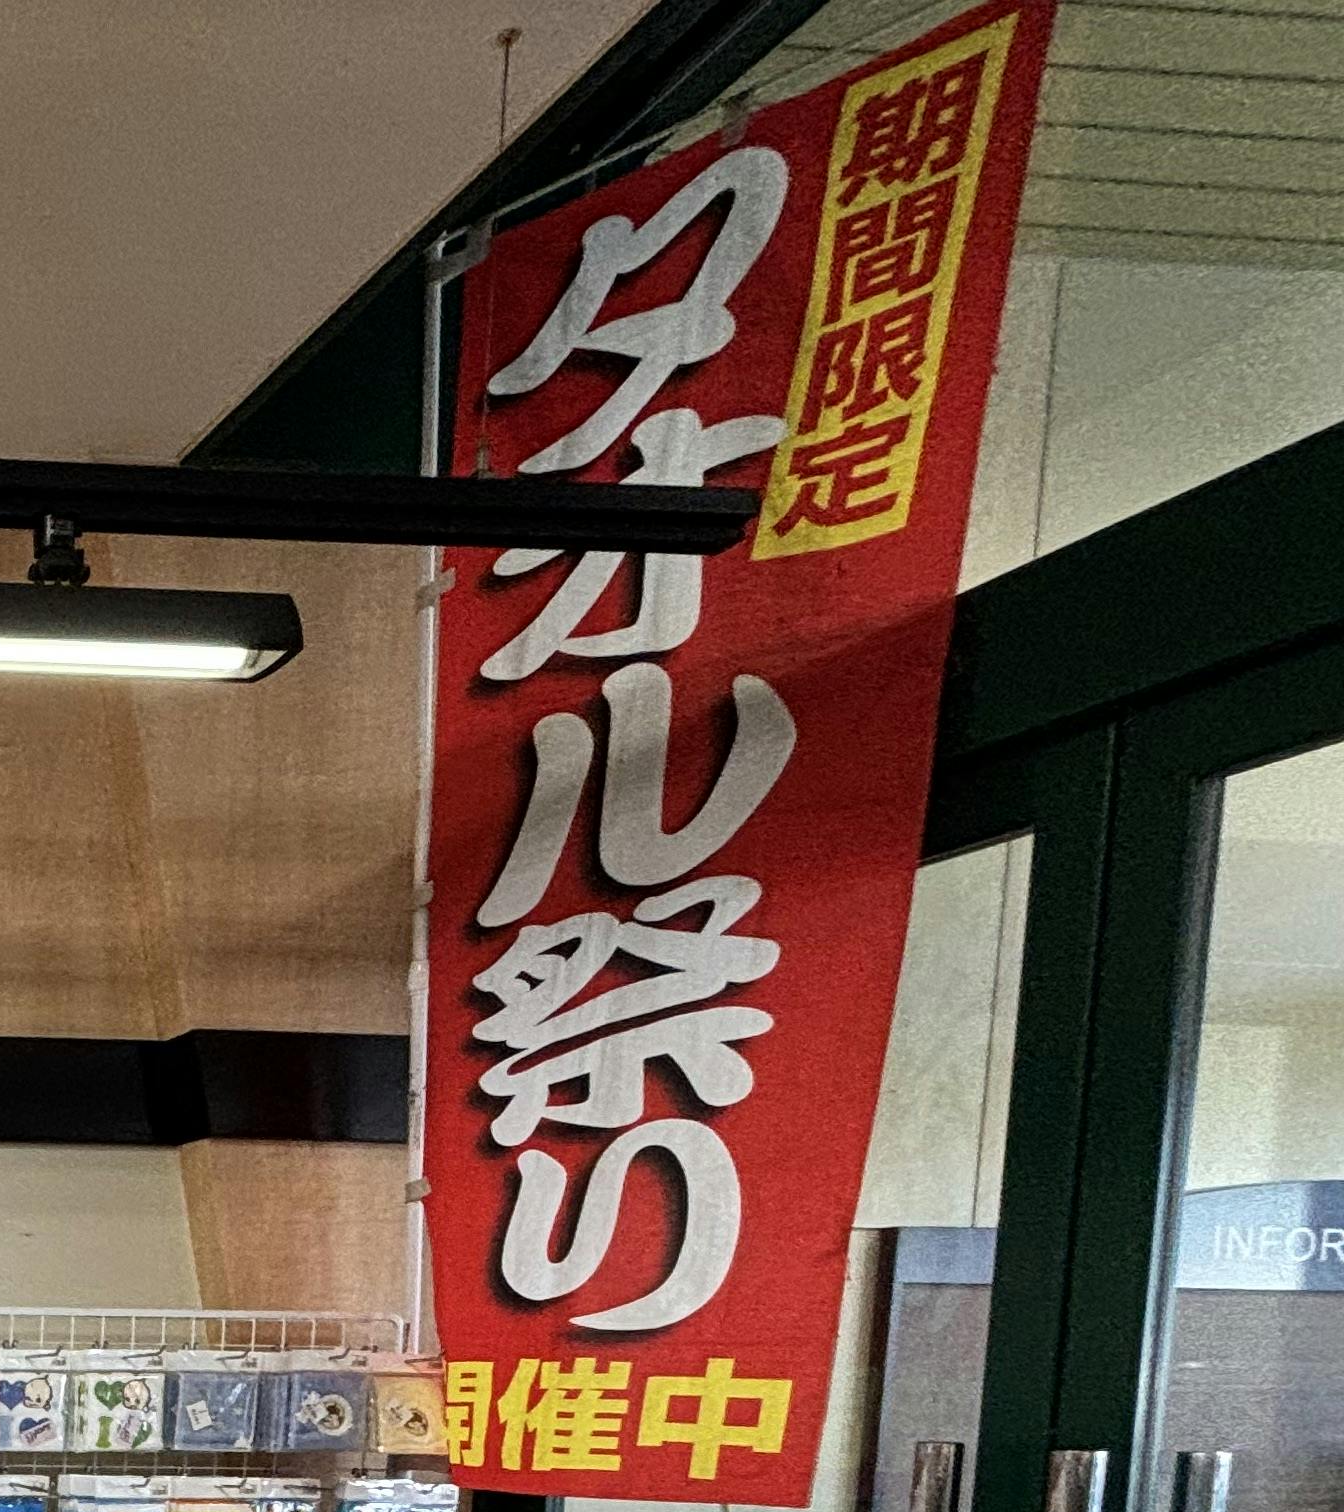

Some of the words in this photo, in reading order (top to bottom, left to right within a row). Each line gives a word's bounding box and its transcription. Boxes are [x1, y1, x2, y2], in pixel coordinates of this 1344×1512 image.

[772, 48, 984, 537] 期間限定
[472, 146, 797, 1331] タオル祭り
